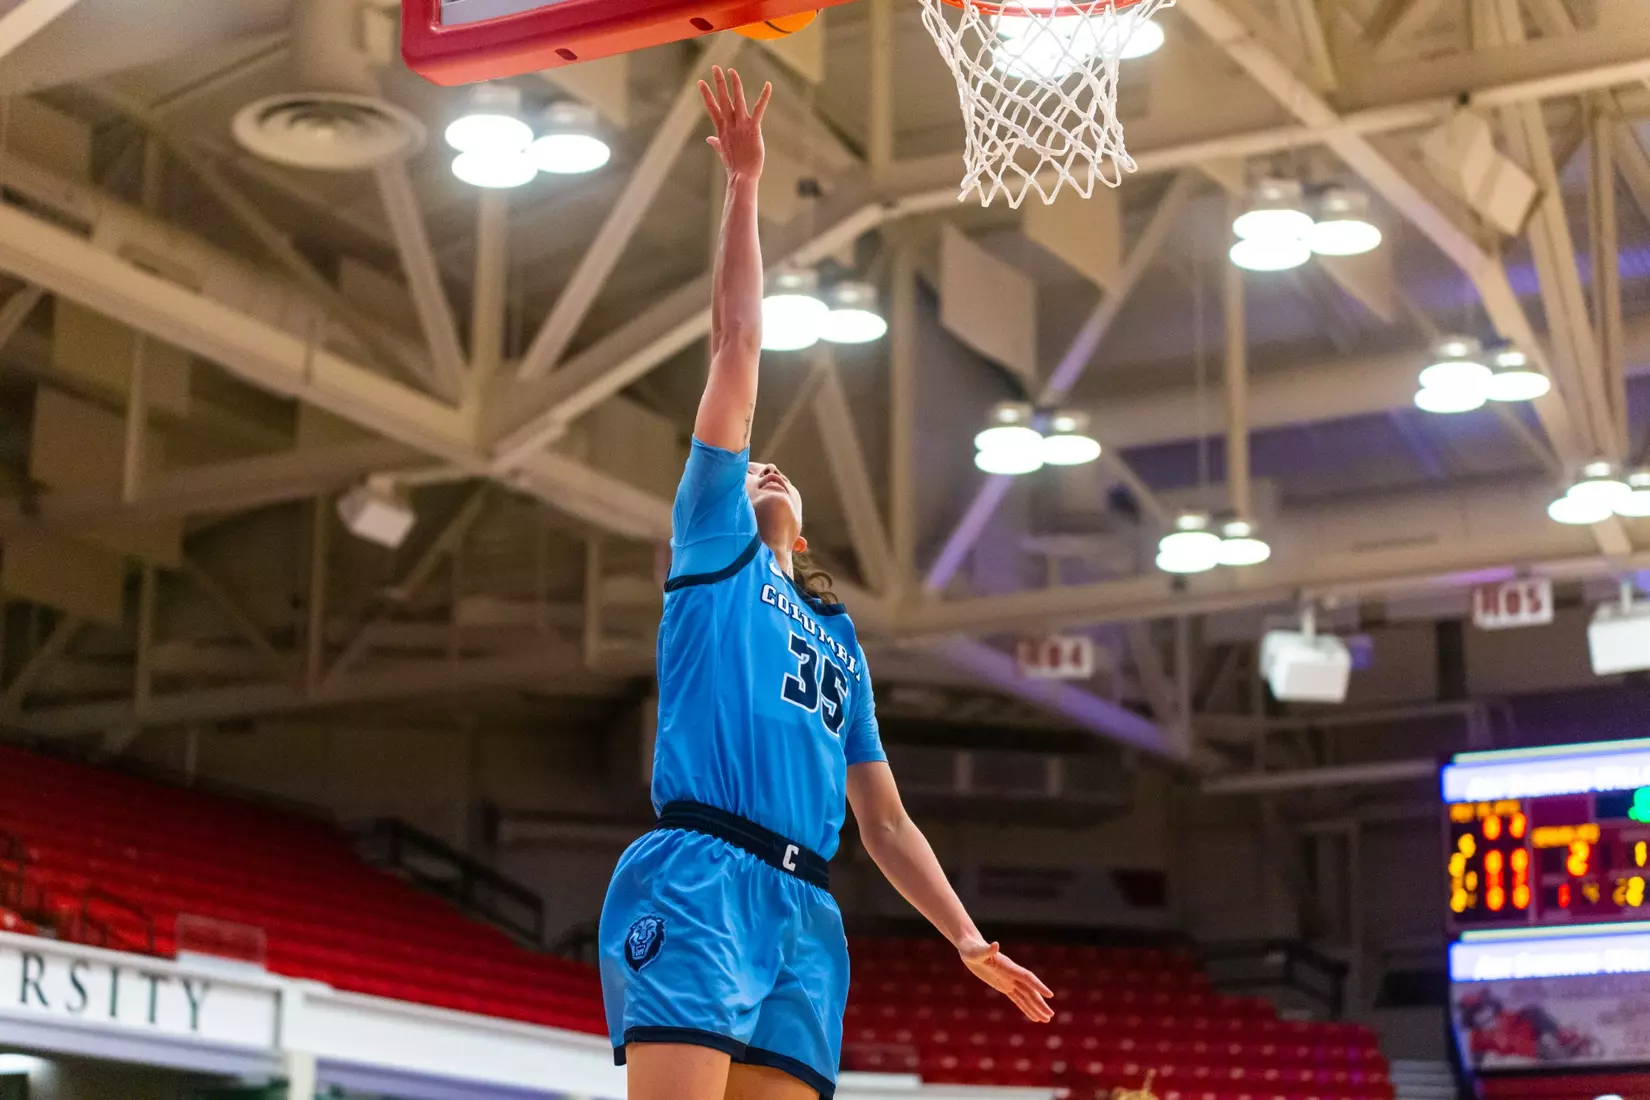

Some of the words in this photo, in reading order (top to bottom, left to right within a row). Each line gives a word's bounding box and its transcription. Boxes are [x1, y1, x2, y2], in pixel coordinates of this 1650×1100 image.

[761, 583, 861, 683] COLUMBI
[780, 630, 849, 738] 35
[782, 843, 800, 872] C
[19, 952, 212, 1031] RSITY
